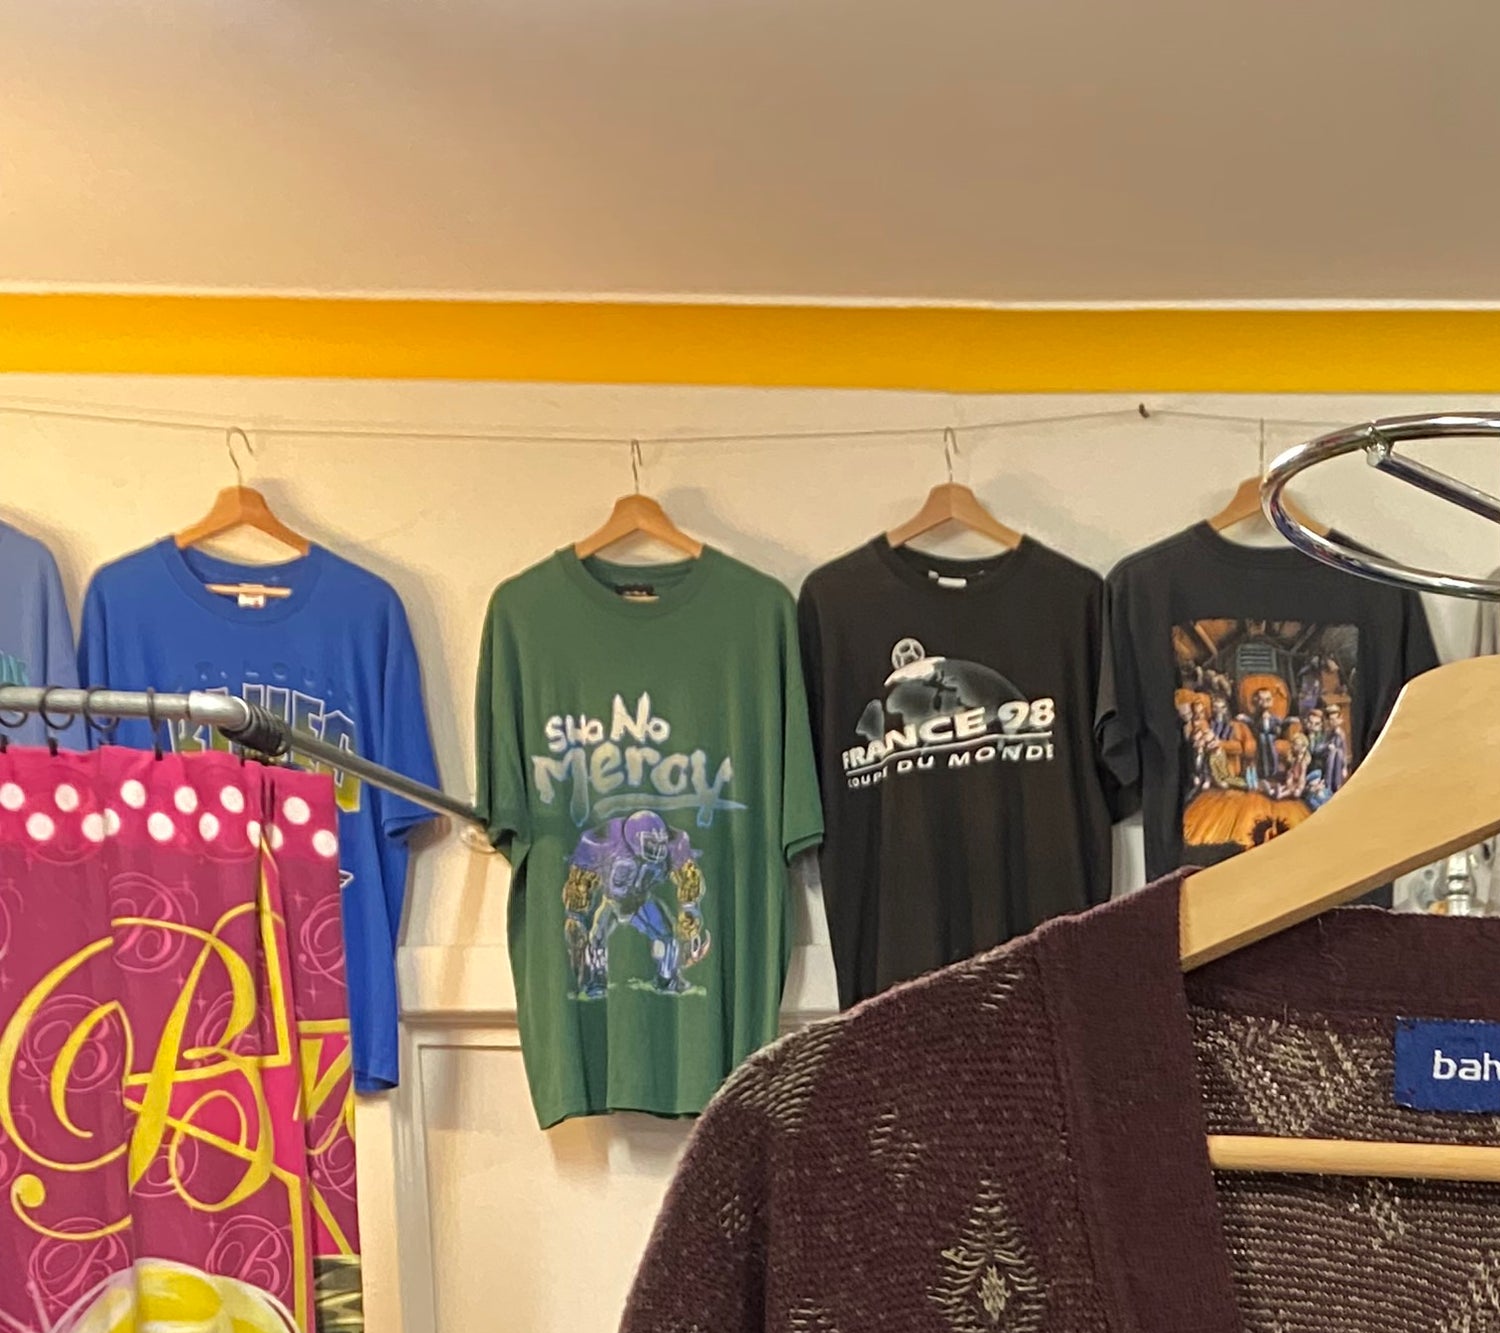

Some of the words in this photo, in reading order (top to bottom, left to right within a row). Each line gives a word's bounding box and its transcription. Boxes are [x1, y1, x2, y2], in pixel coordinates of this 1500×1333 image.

[609, 691, 670, 743] No
[842, 706, 987, 770] FRANCE
[998, 697, 1055, 736] 98
[896, 755, 935, 773] DU
[948, 743, 1054, 768] MONDE
